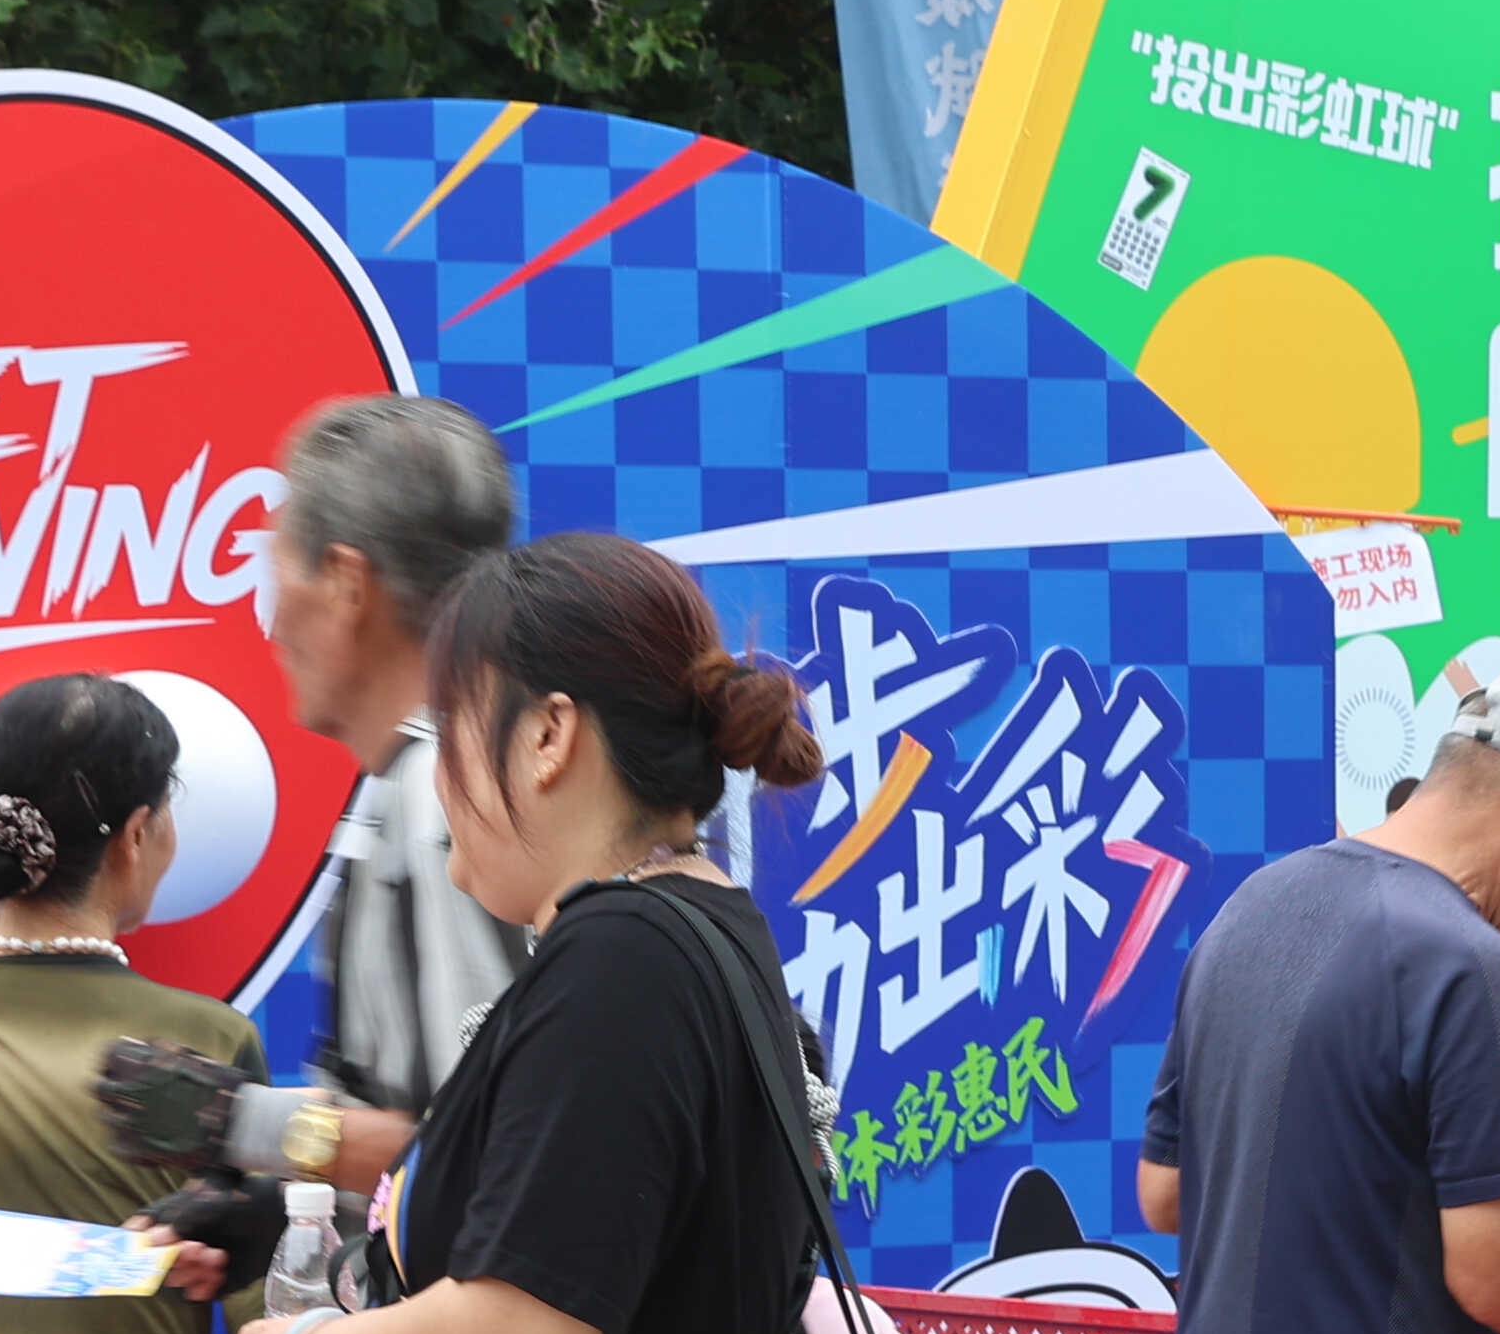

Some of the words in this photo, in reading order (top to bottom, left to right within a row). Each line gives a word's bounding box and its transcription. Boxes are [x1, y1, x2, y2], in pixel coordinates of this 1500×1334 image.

[1131, 29, 1460, 171] "投出彩虹球"
